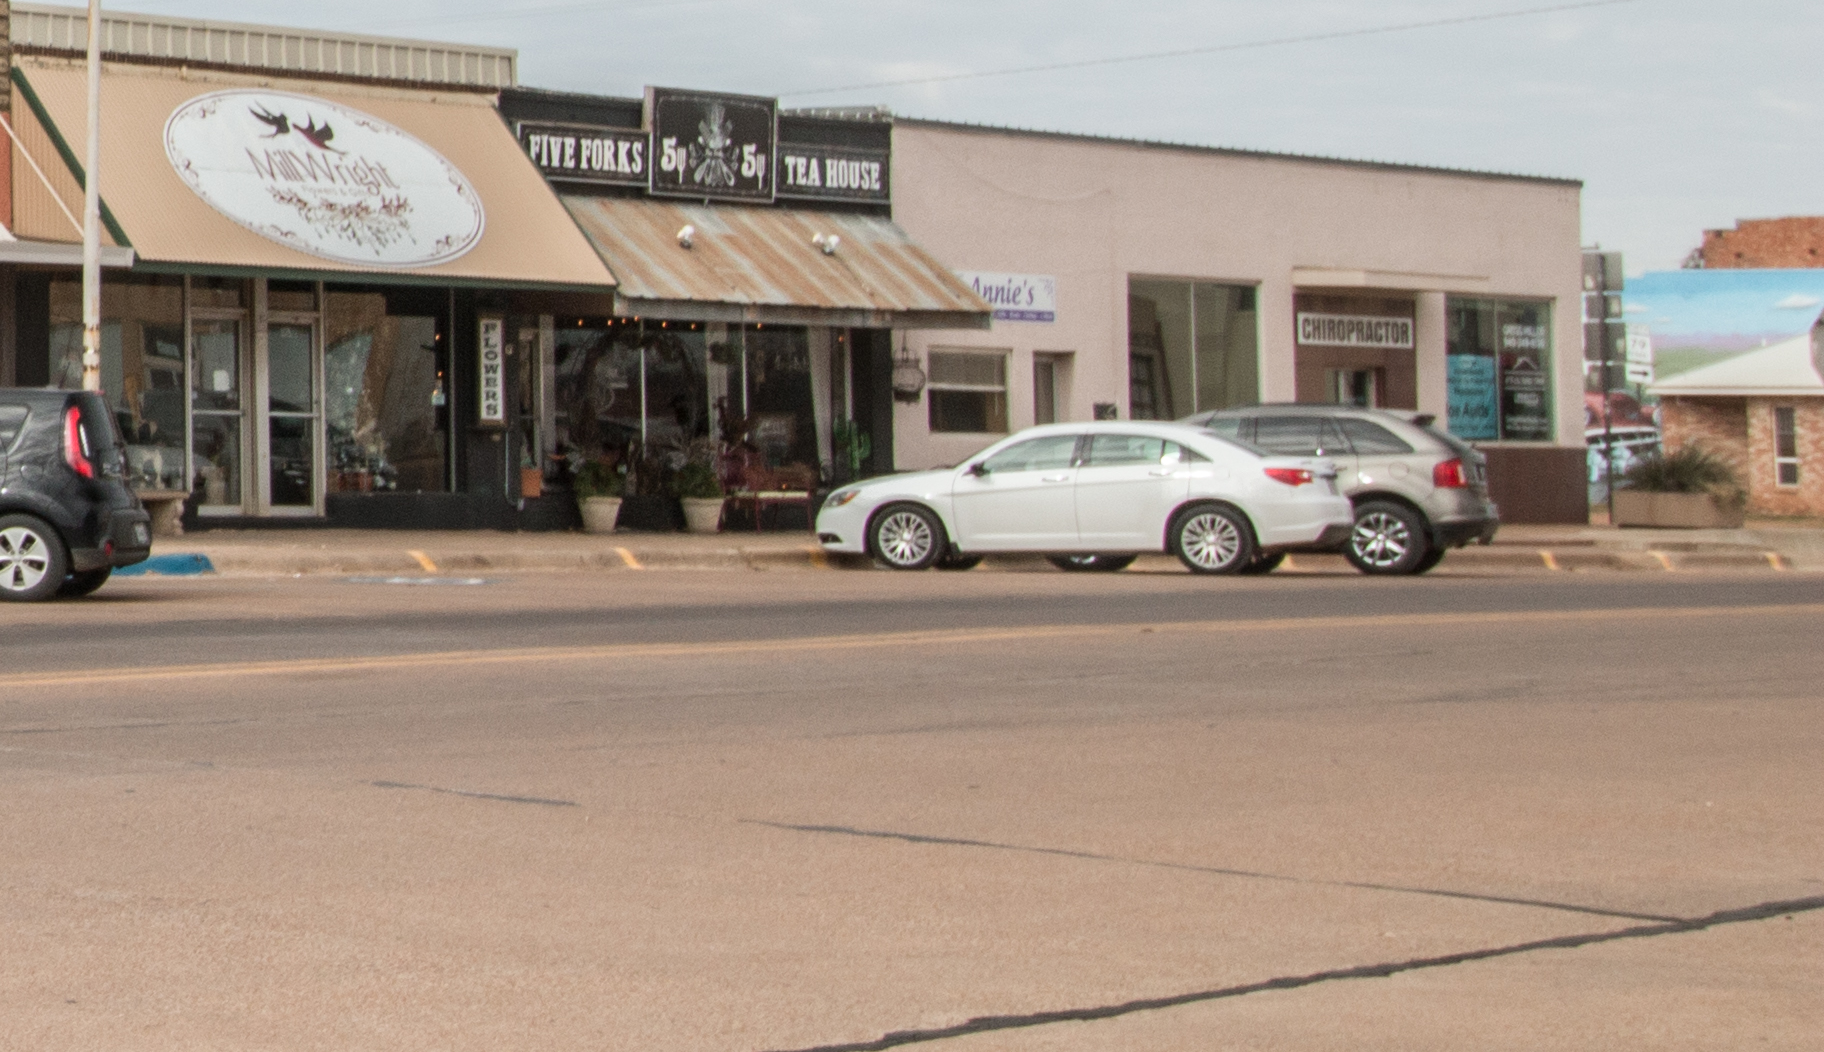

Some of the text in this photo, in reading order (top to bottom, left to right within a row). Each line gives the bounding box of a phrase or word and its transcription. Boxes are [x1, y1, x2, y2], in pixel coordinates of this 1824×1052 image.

[245, 147, 400, 196] MillWright
[529, 134, 643, 174] FIVE FORKS
[661, 137, 677, 172] 5
[741, 143, 758, 177] 5
[785, 156, 881, 191] TEA HOUSE
[971, 276, 1035, 306] Annie's
[1301, 317, 1410, 346] CHIROPRACTOR
[483, 322, 499, 416] FLOWERS
